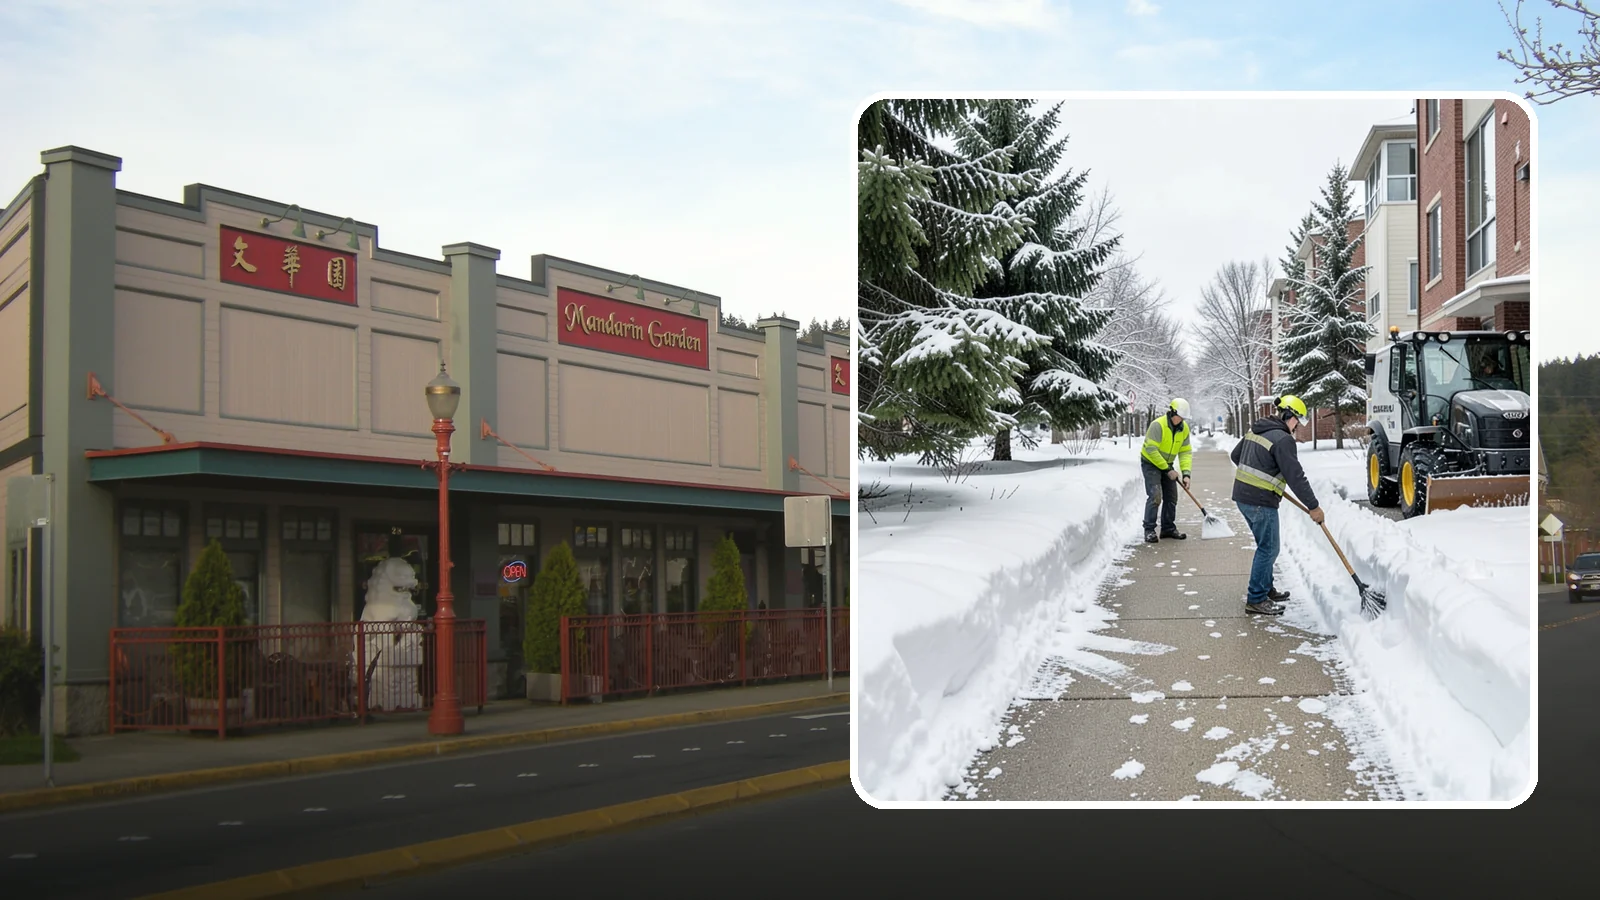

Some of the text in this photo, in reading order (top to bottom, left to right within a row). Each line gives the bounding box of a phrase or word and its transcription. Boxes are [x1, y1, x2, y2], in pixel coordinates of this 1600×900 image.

[231, 235, 346, 291] 文華園
[564, 302, 701, 352] Mandarin Garden
[503, 565, 527, 578] OPEN
